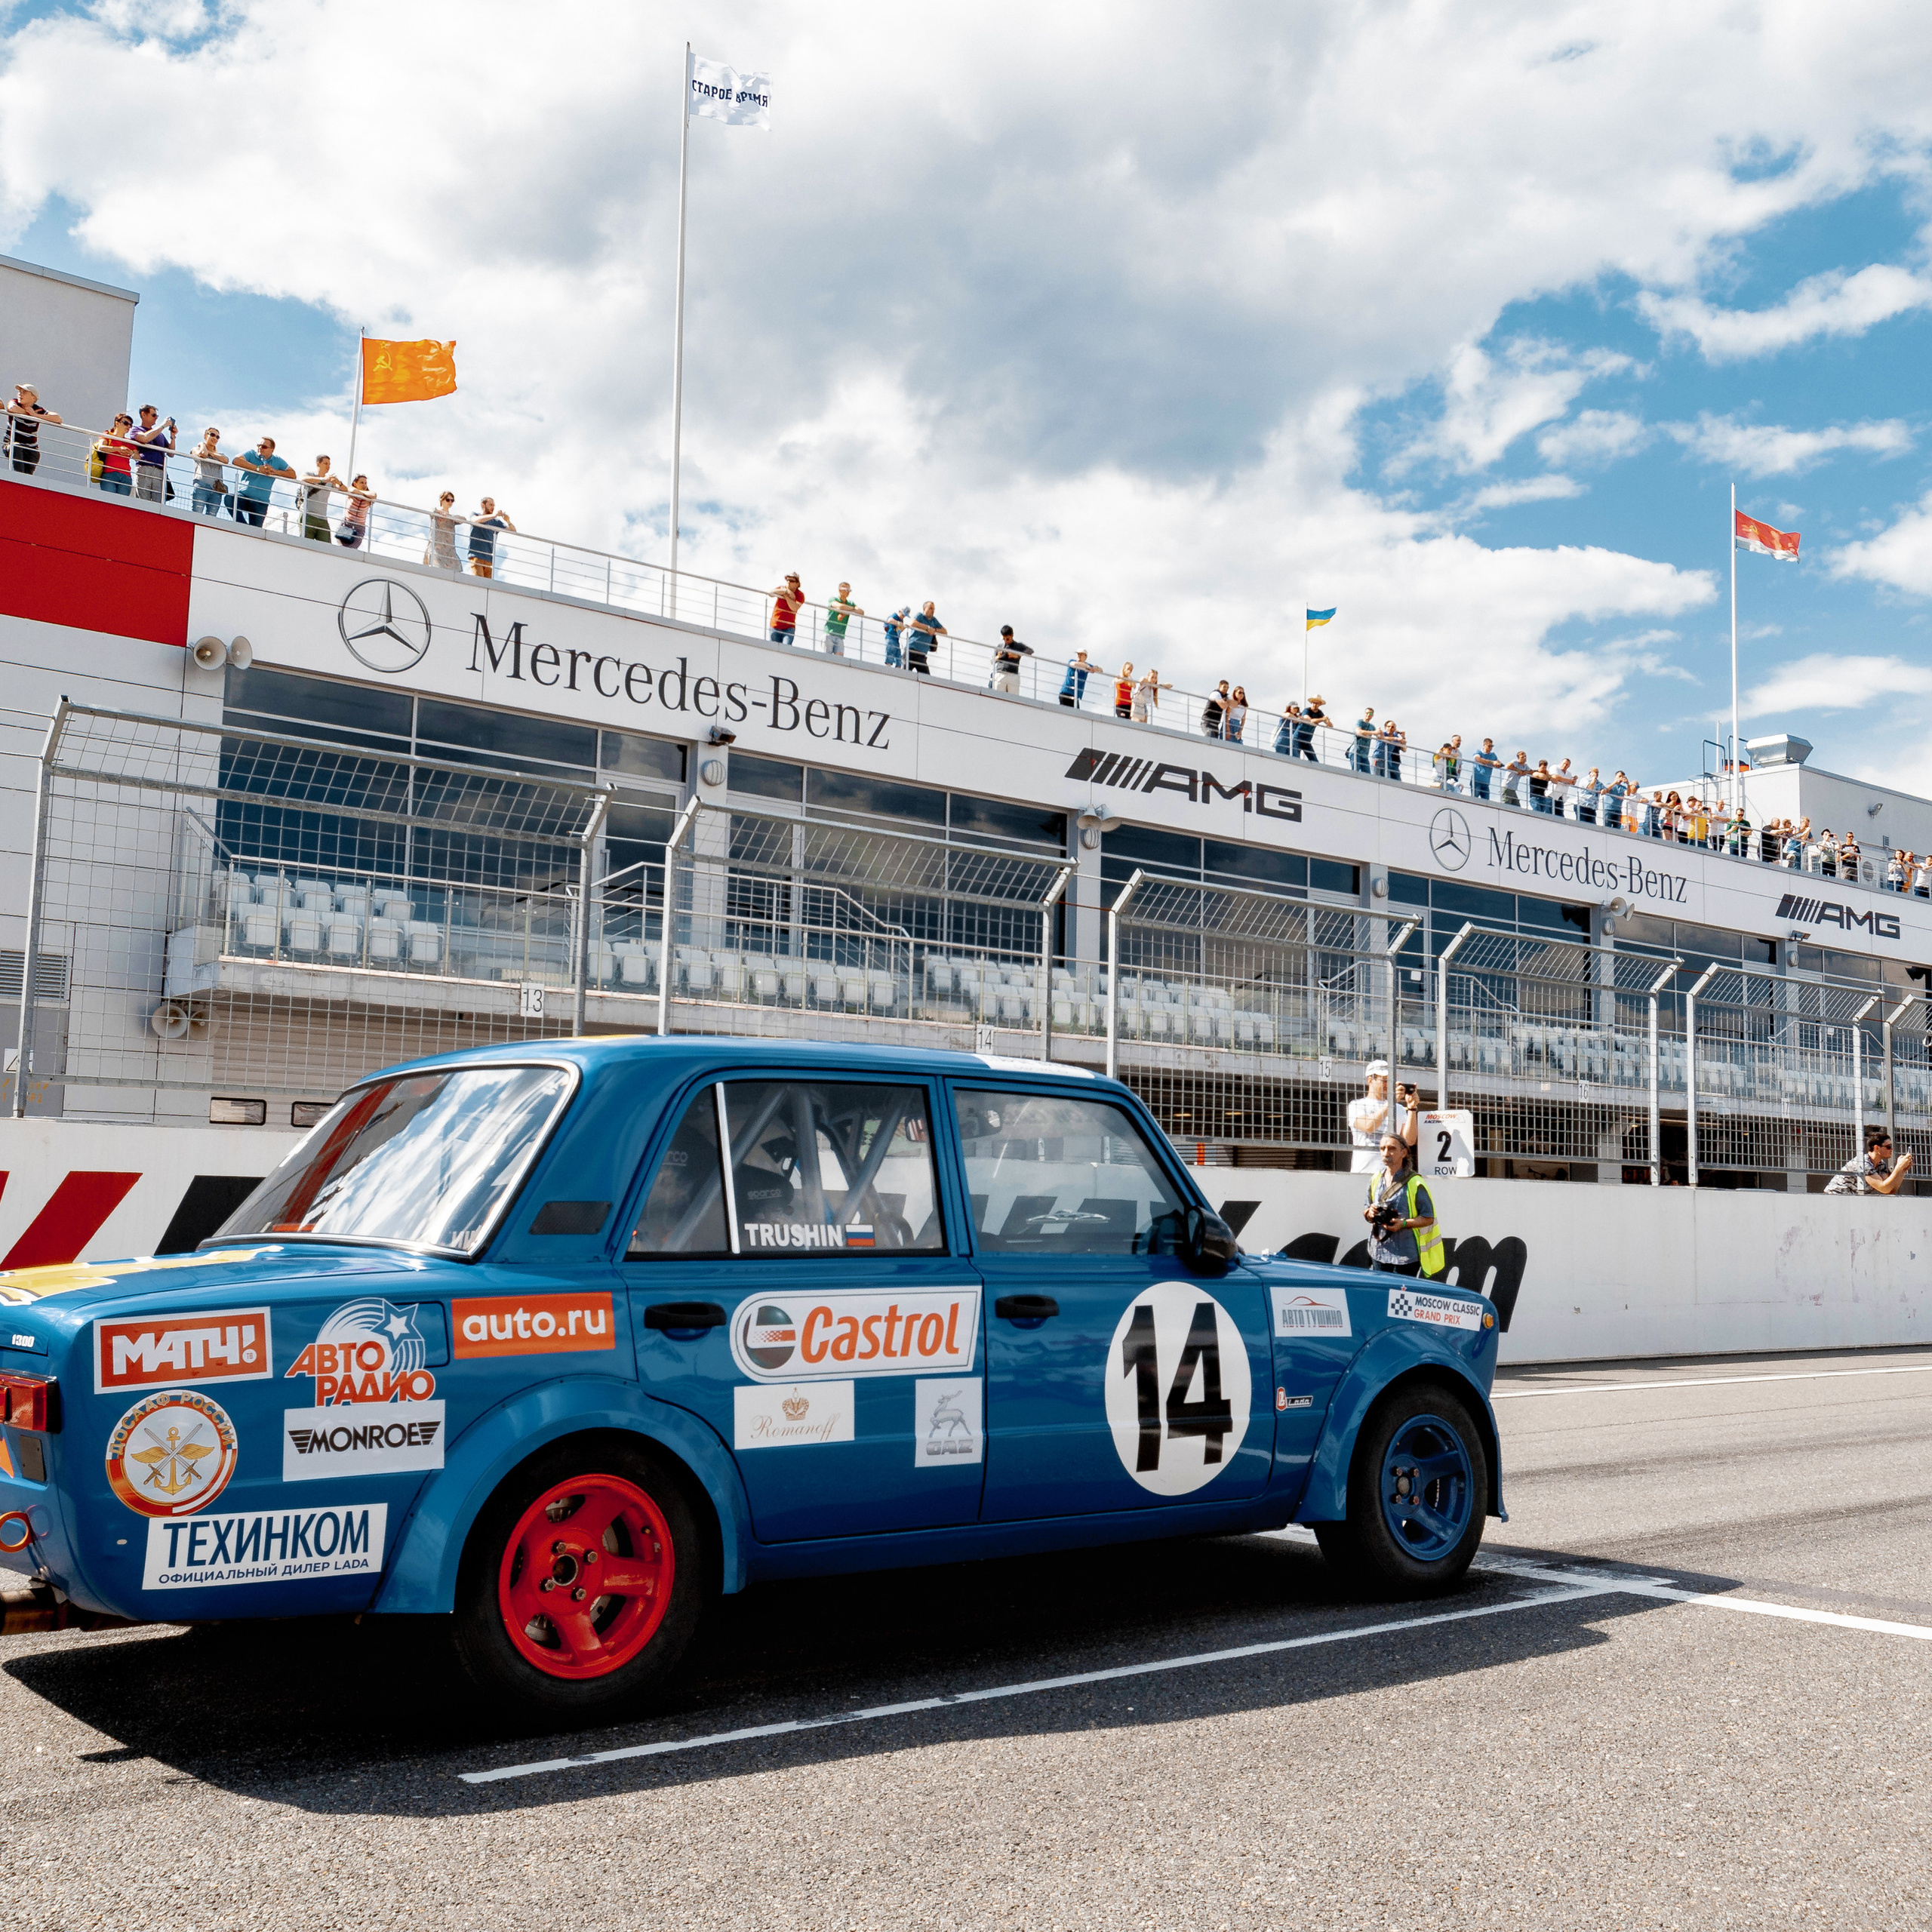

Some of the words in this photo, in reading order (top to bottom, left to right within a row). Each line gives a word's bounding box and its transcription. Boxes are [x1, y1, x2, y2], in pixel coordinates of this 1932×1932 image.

[692, 79, 732, 100] СТАРОЕ
[466, 612, 891, 750] Mercedes-Benz
[1141, 763, 1302, 823] AMG
[1487, 826, 1687, 903] Mercedes-Benz
[1814, 901, 1900, 940] AMG
[523, 989, 543, 1012] 13
[978, 1029, 992, 1050] 14
[1320, 1060, 1331, 1078] 15
[1580, 1083, 1589, 1100] 16
[1437, 1131, 1452, 1162] 2
[1435, 1167, 1457, 1176] ROW
[744, 1223, 844, 1247] TRUSHIN
[1414, 1309, 1441, 1322] GRAND
[1444, 1314, 1461, 1325] PRIX
[1415, 1296, 1451, 1311] MOSCOW
[1452, 1303, 1480, 1316] CLASSIC
[462, 1307, 606, 1342] auto.ru
[801, 1303, 959, 1363] Castrol
[11, 1334, 35, 1348] 1300
[112, 1324, 257, 1375] МАТЧ!
[285, 1340, 385, 1377] АВТО
[315, 1369, 435, 1407] РАДИО
[1122, 1303, 1232, 1472] 14
[109, 1393, 170, 1456] ДОСААФ
[180, 1392, 235, 1446] РОССИИ
[307, 1423, 421, 1454] MONROE
[751, 1412, 841, 1441] Romanoff
[926, 1439, 973, 1456] GAZ
[163, 1510, 369, 1568] ТЕХИНКОМ
[158, 1563, 277, 1584] ОФИЦИАЛЬНЫЙ
[281, 1562, 330, 1577] ДИЛЕР
[334, 1558, 369, 1571] LADA
